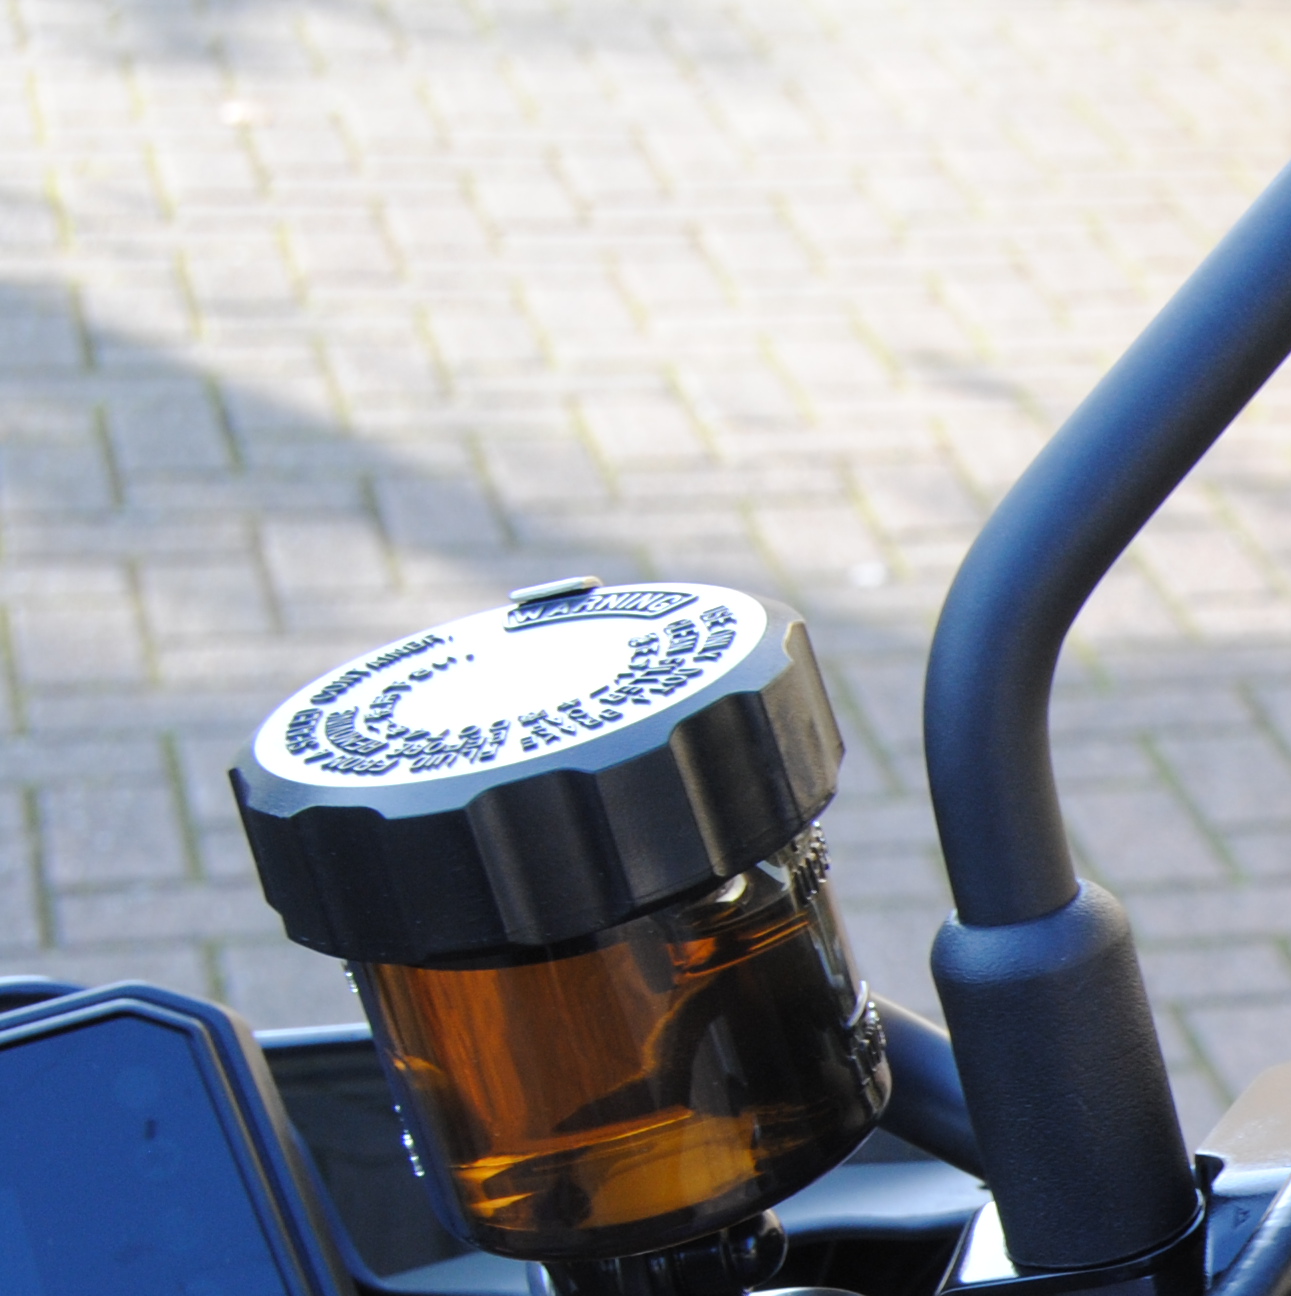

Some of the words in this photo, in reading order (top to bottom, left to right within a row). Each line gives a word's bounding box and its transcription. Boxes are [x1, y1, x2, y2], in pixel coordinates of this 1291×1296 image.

[514, 592, 677, 622] WARNING
[285, 707, 323, 756] SEALED
[386, 730, 507, 759] BEFORE
[520, 708, 624, 753] BRAKE
[320, 754, 400, 776] FROM
[409, 736, 498, 774] FLUID
